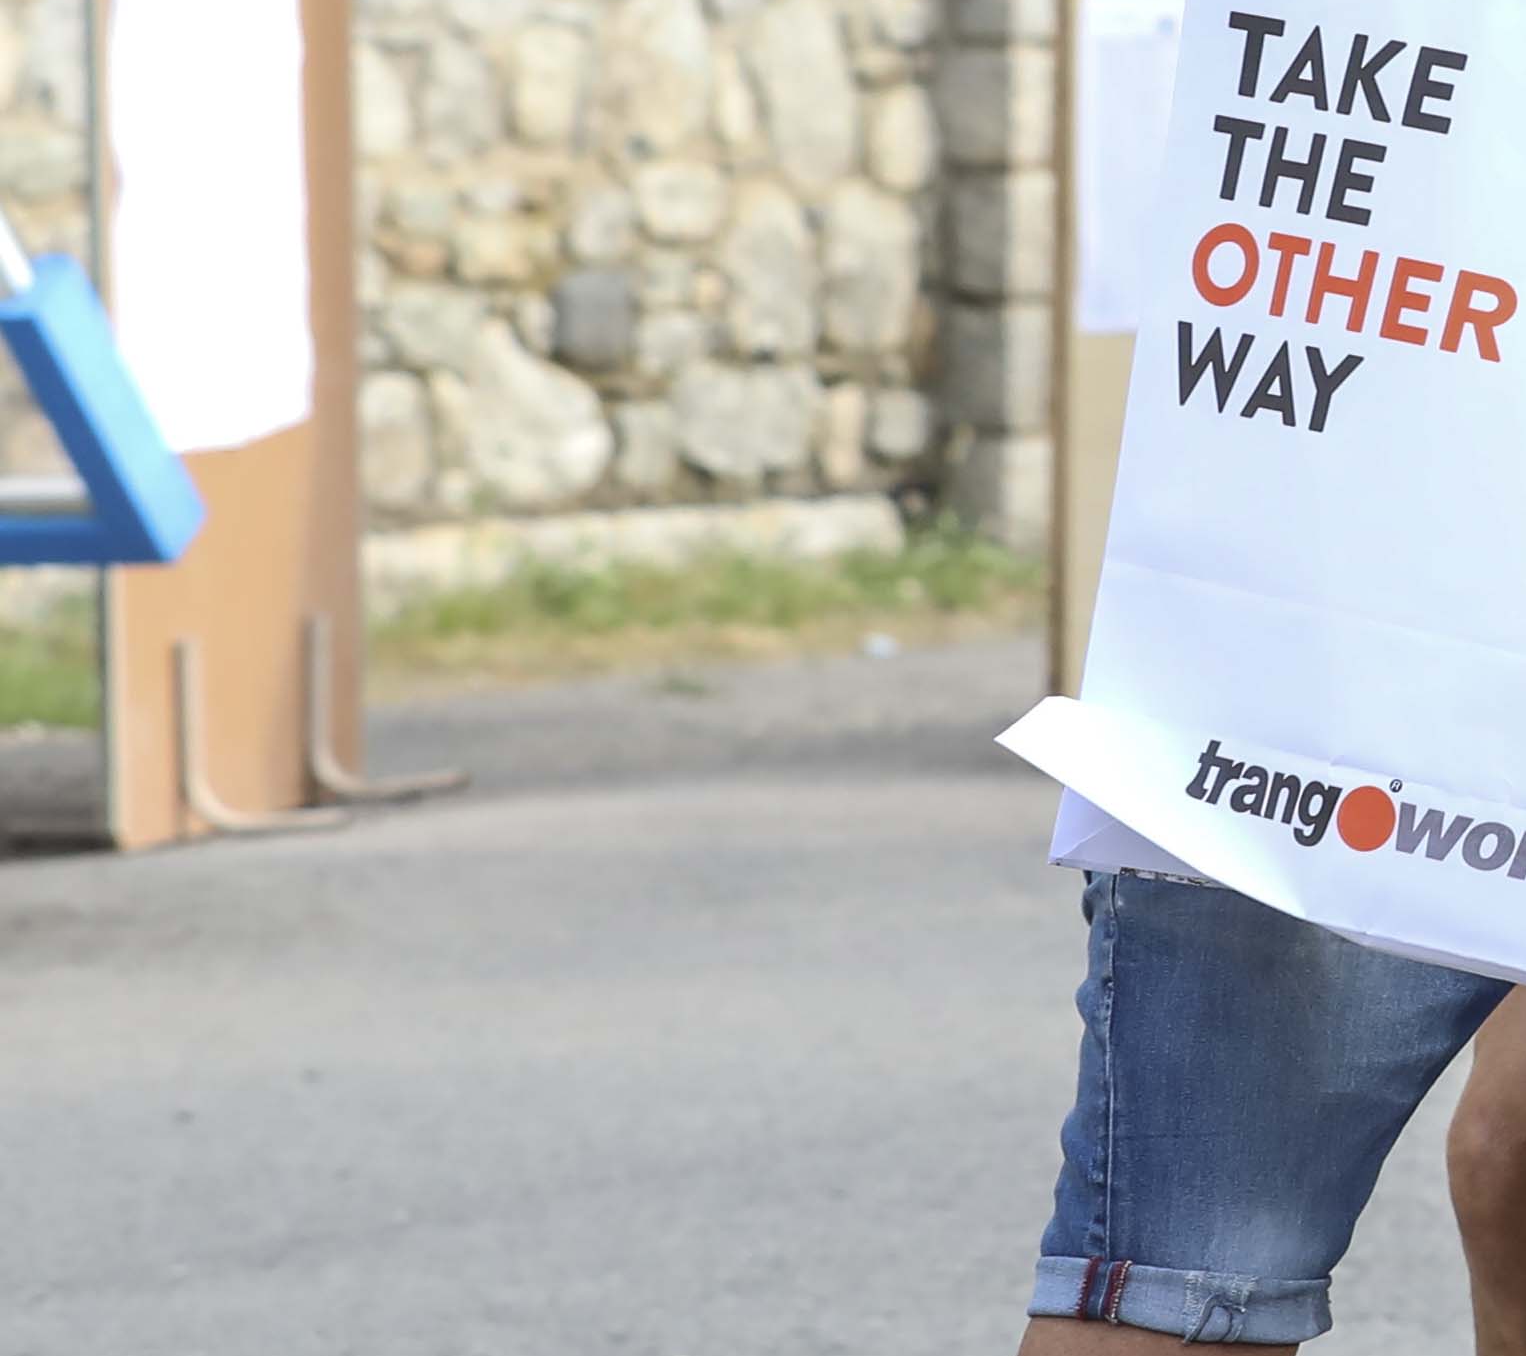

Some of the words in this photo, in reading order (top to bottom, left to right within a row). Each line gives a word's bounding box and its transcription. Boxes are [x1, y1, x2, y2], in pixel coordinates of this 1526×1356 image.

[1228, 11, 1468, 134] TAKE
[1212, 114, 1388, 227] THE
[1191, 222, 1517, 364] OTHER
[1176, 319, 1363, 432] WAY
